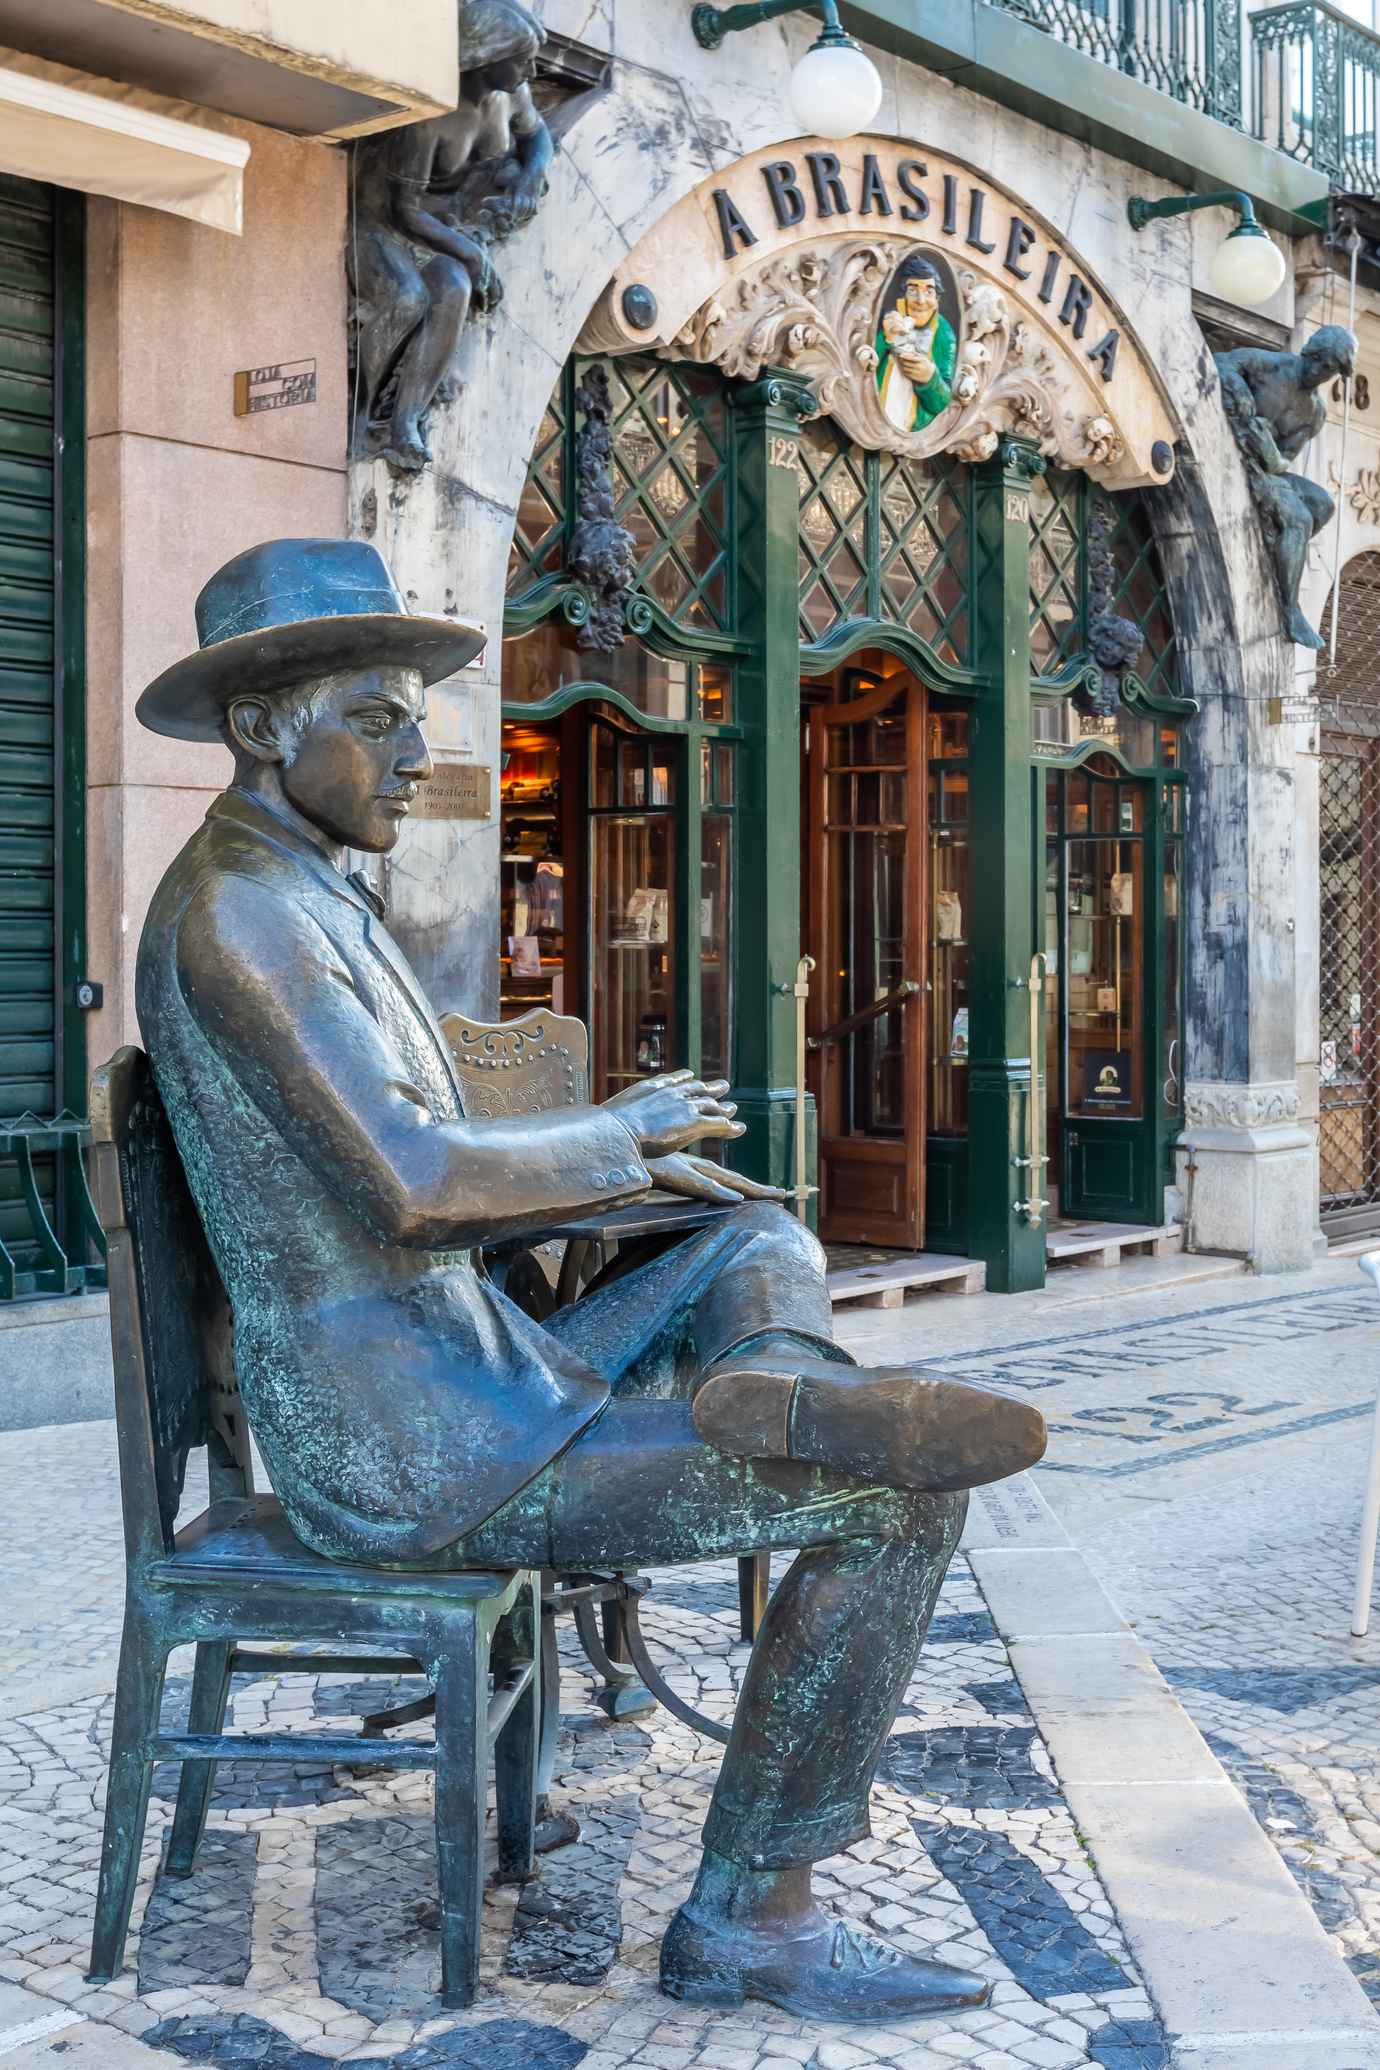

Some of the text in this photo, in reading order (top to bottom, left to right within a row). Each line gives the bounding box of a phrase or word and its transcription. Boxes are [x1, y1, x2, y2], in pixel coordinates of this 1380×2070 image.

[711, 152, 1121, 383] A BRASILEIRA
[768, 437, 800, 470] 122
[1006, 494, 1030, 525] 120
[425, 783, 478, 798] Brasileira
[952, 1296, 1380, 1391] BRASILEIR
[1046, 1391, 1302, 1445] 122
